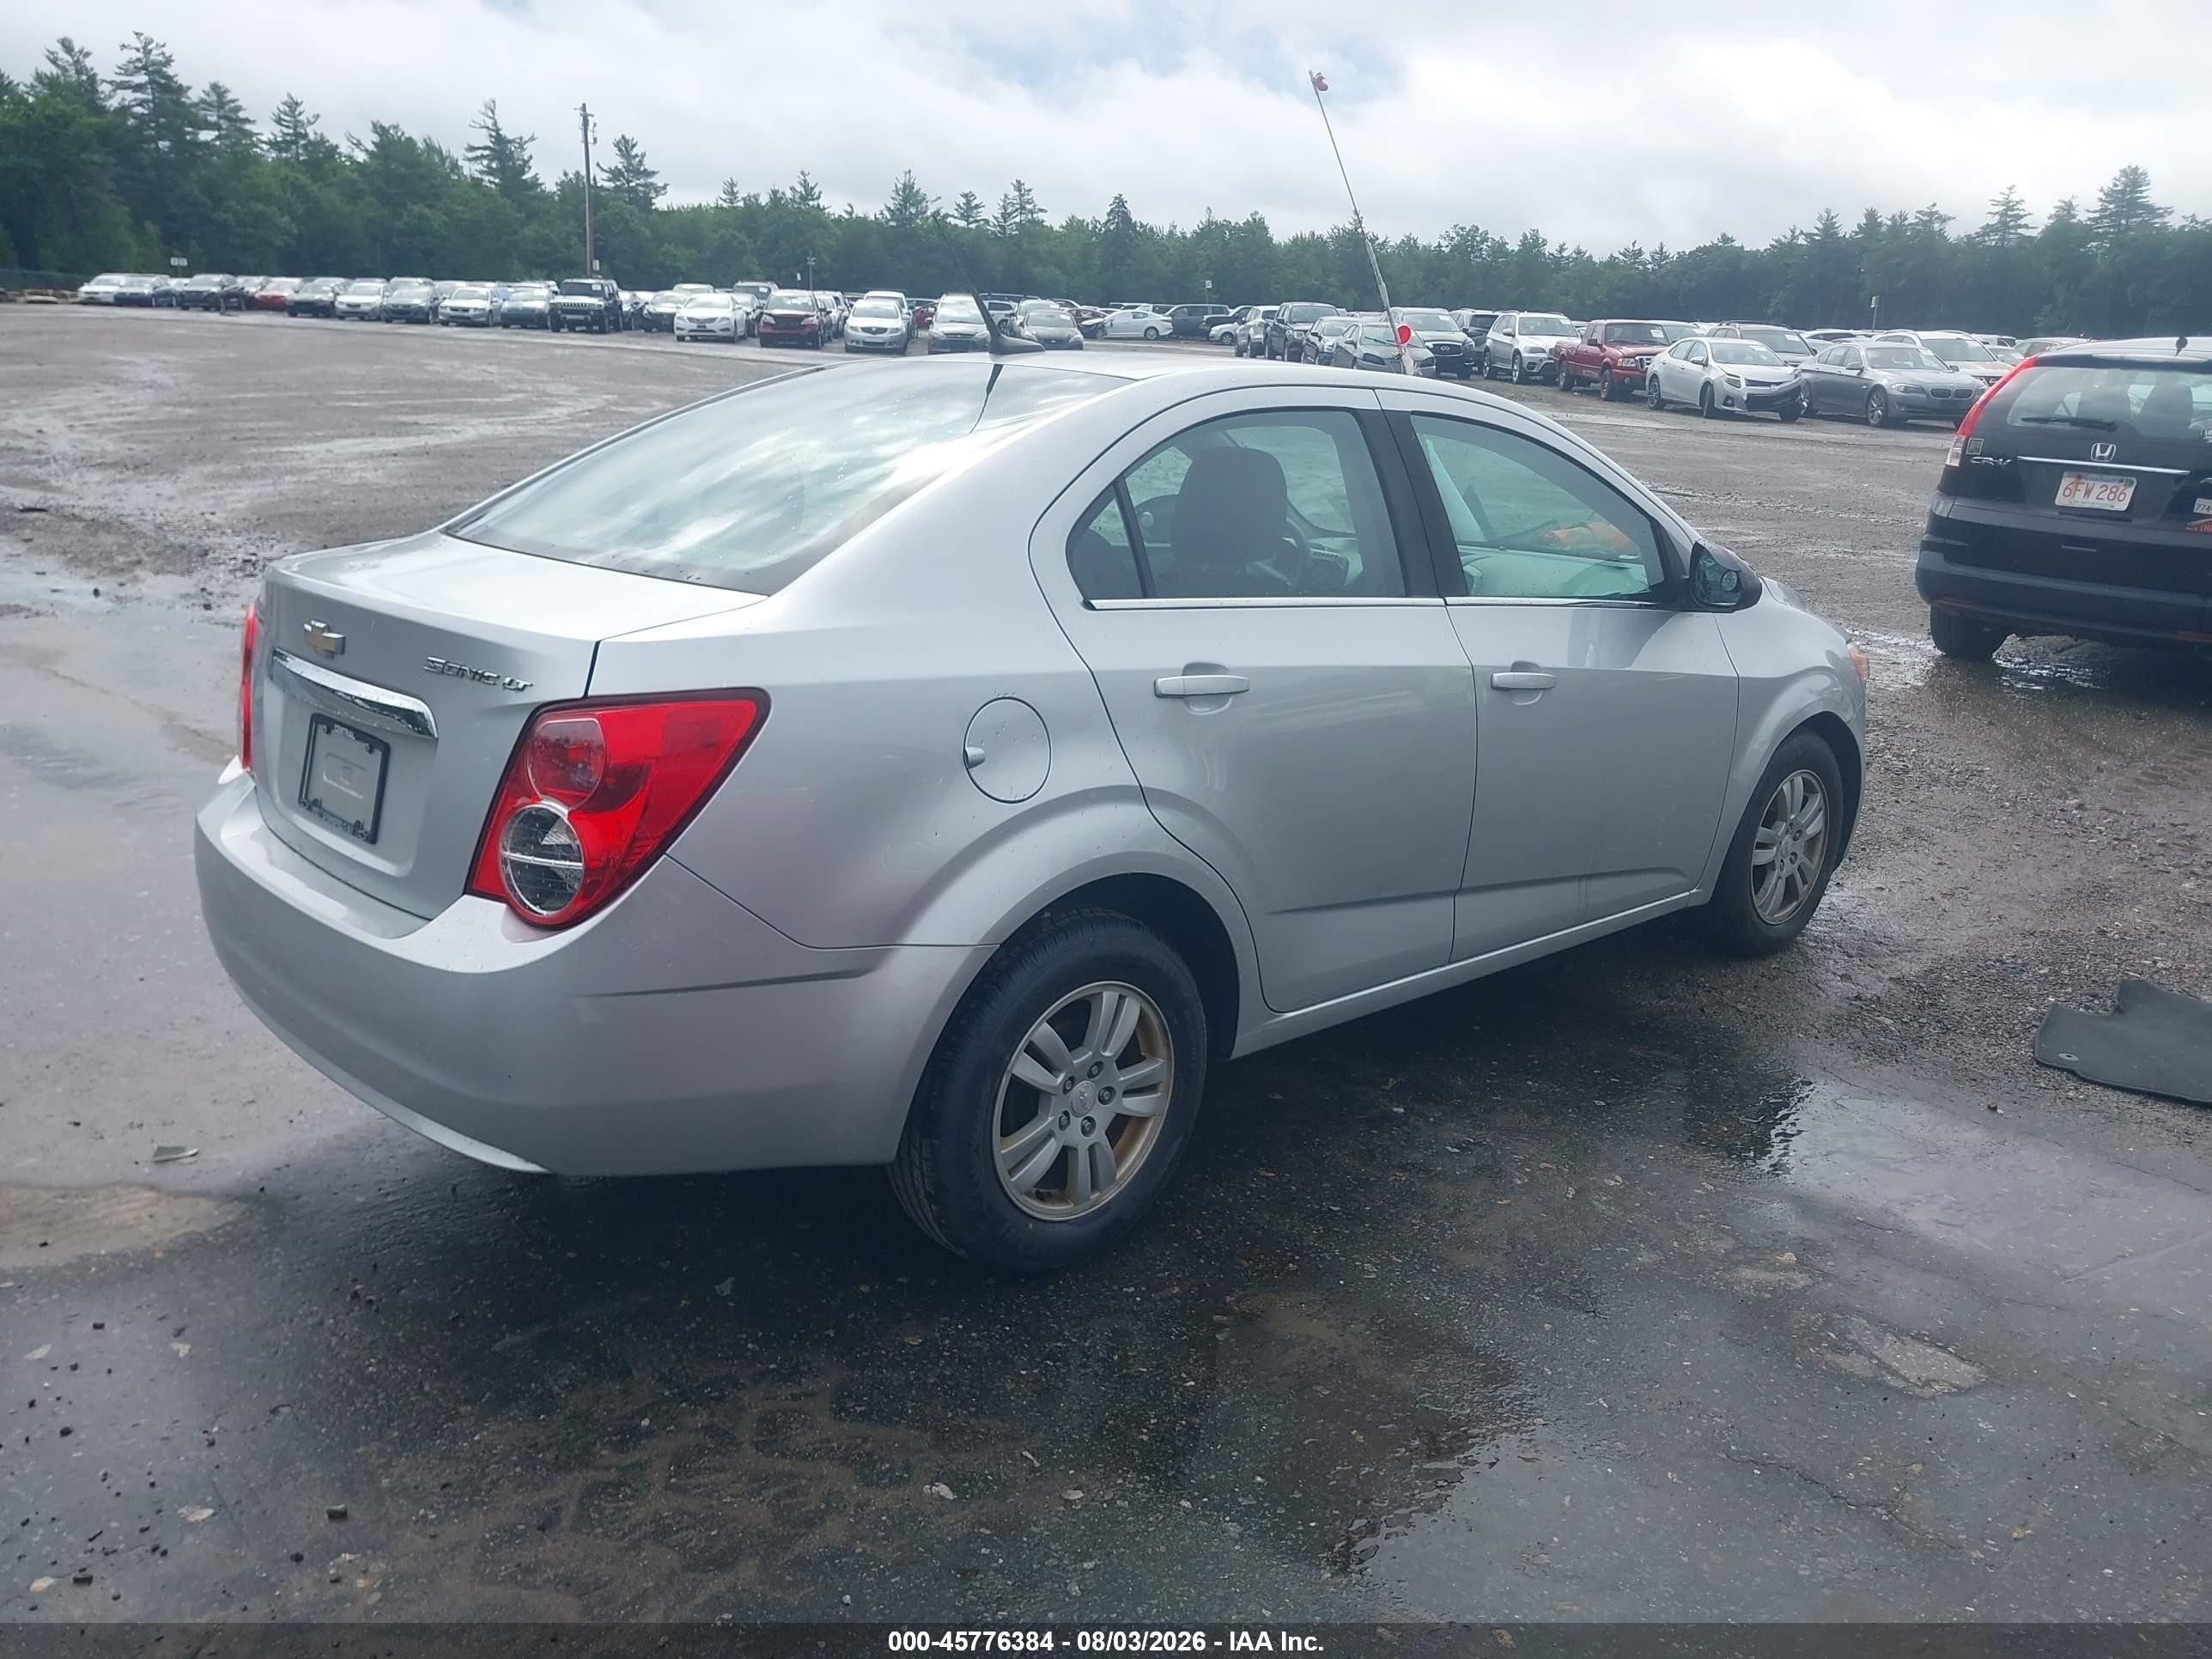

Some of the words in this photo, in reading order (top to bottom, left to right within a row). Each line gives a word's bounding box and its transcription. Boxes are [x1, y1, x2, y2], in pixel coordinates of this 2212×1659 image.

[2063, 481, 2095, 499] 6FW
[2095, 483, 2127, 501] 286
[423, 656, 500, 685] SONIC
[502, 676, 533, 691] LT
